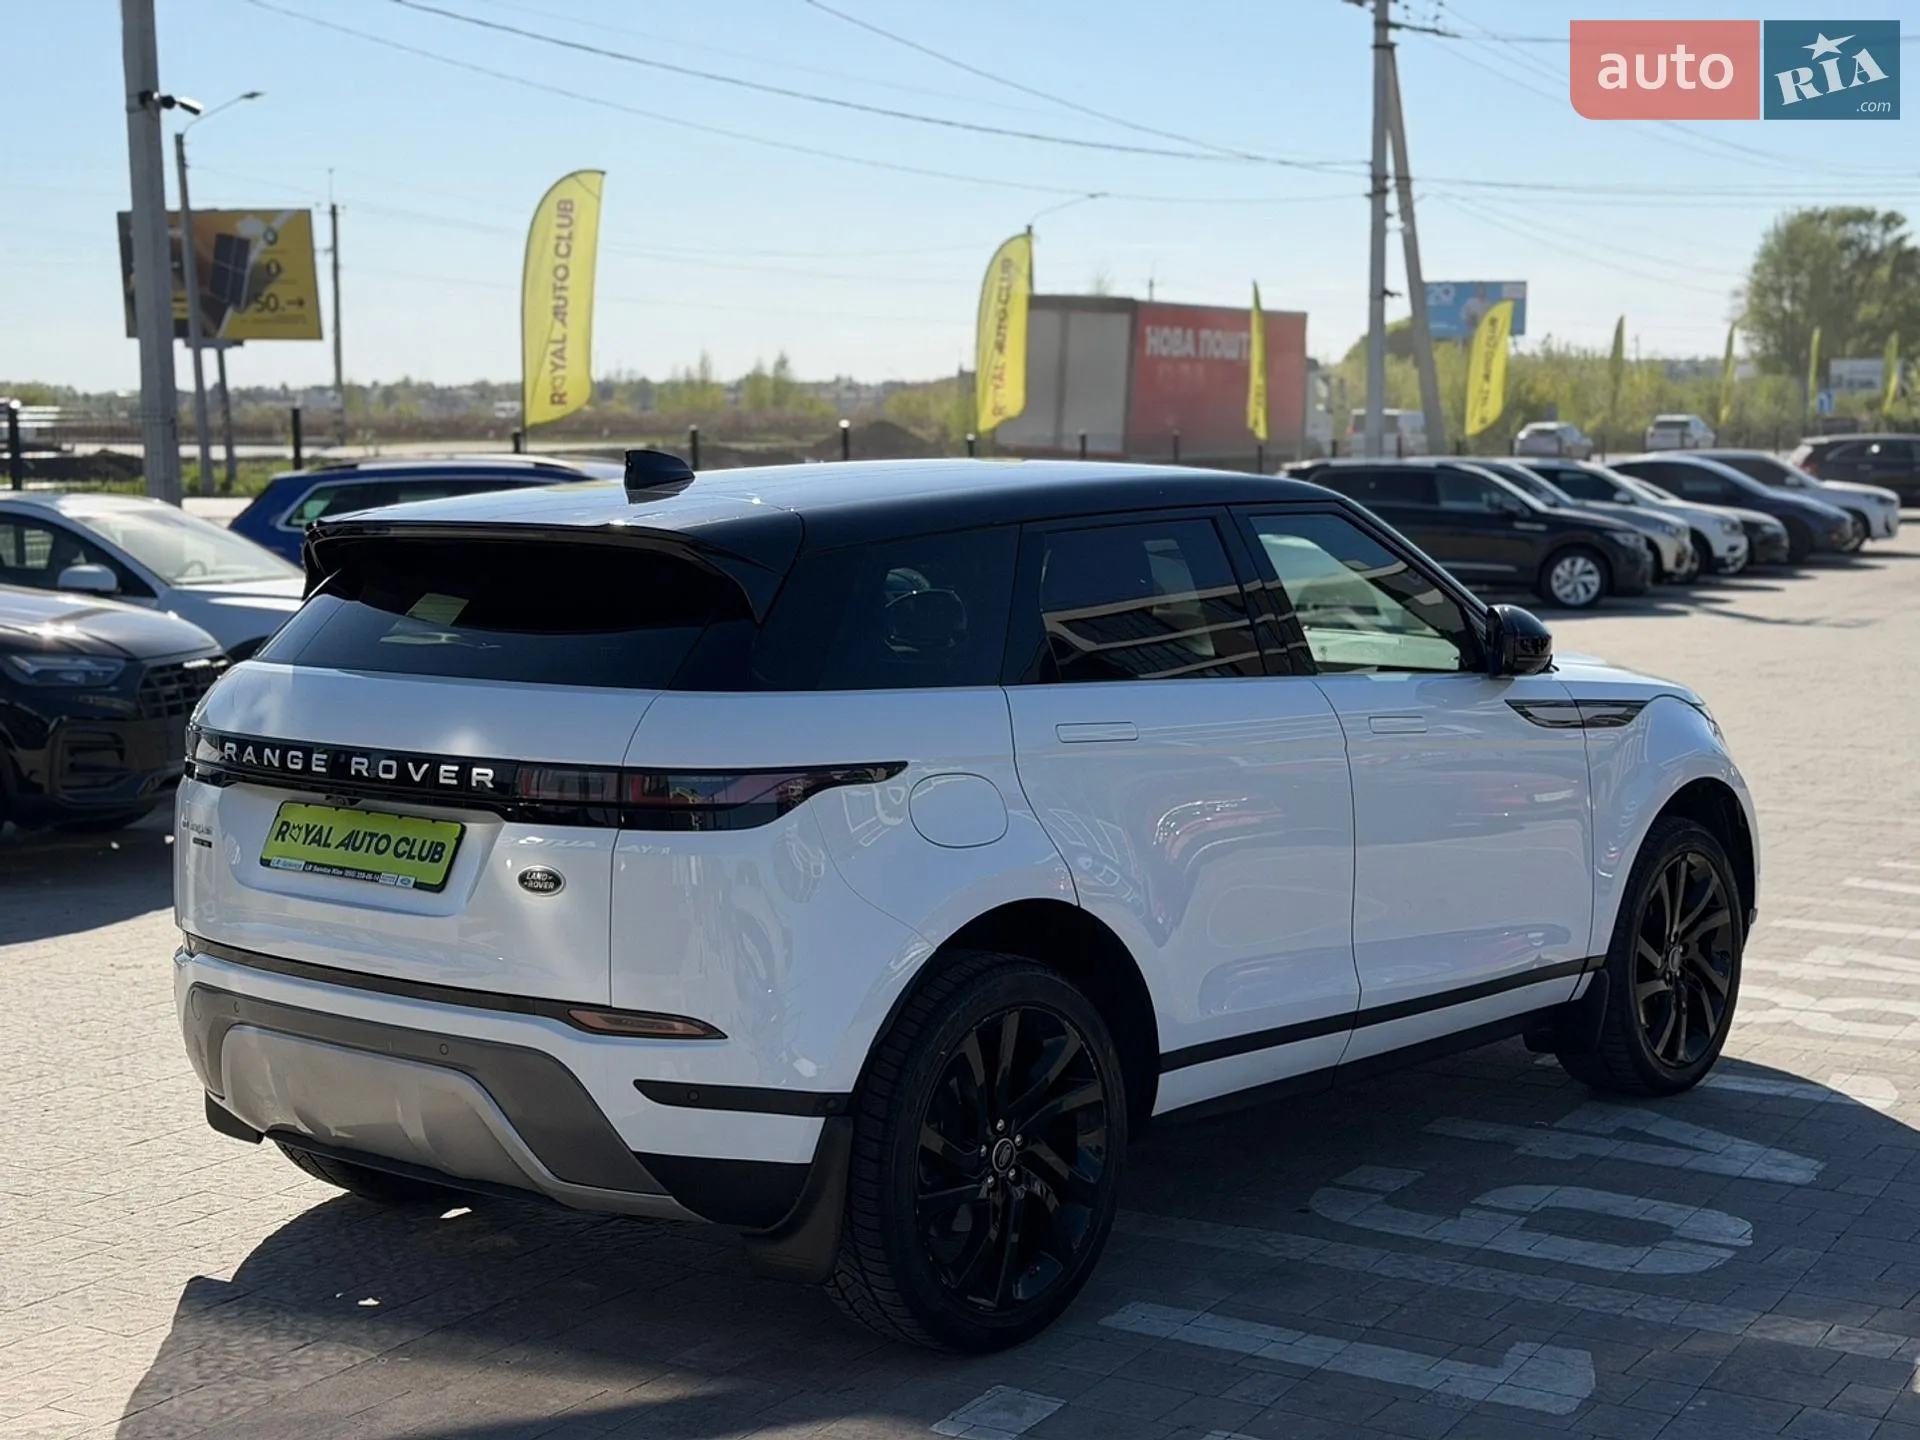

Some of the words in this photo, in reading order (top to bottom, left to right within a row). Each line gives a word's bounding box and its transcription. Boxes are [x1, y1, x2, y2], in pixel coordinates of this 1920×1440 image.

[553, 198, 575, 259] CLUB
[551, 263, 570, 328] AUTO
[1145, 325, 1195, 358] НОВА
[1199, 327, 1251, 361] ПОШТ
[223, 741, 328, 773] RANGE
[350, 756, 495, 789] ROVER
[334, 829, 393, 855] AUTO
[393, 836, 447, 864] CLUB
[526, 871, 548, 881] LAND
[528, 880, 555, 889] ROVER
